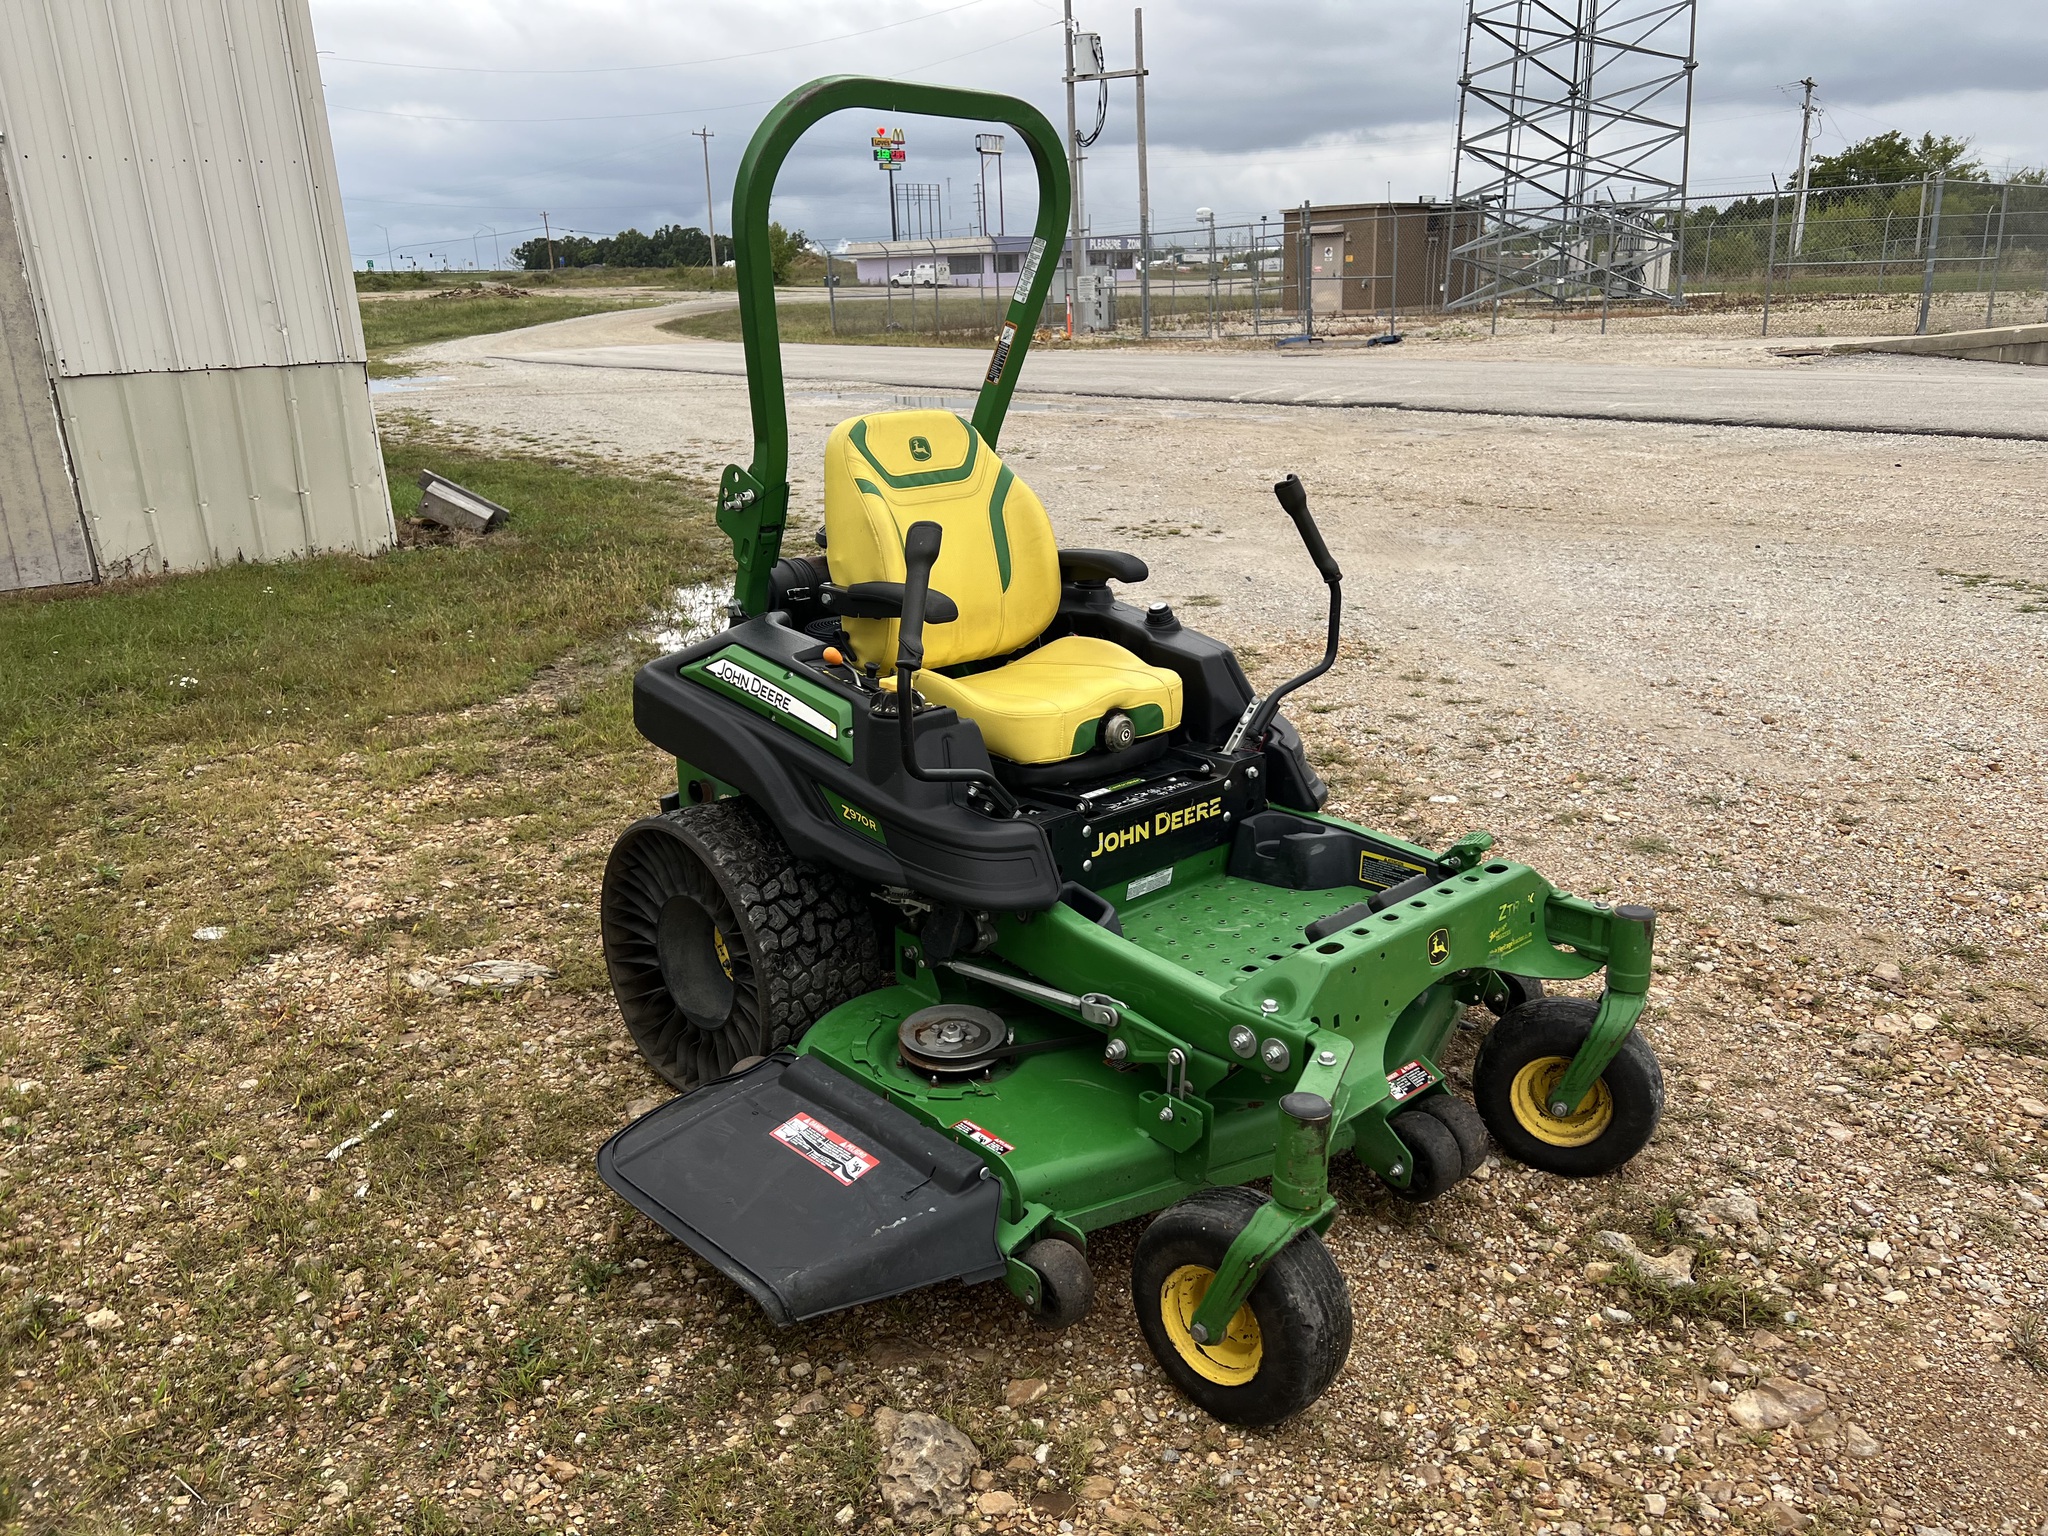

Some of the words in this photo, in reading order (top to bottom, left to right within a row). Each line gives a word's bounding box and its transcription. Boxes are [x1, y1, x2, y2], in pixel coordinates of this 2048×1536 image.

[1089, 239, 1121, 250] PLEASURE
[1126, 238, 1141, 250] ZON
[717, 662, 750, 688] JOHN
[751, 677, 792, 712] DEERE
[841, 804, 877, 831] Z970R
[1091, 821, 1150, 858] JOHN
[1155, 797, 1222, 836] DEERE
[809, 1118, 830, 1135] DANGER
[844, 1142, 868, 1159] PELIGRO
